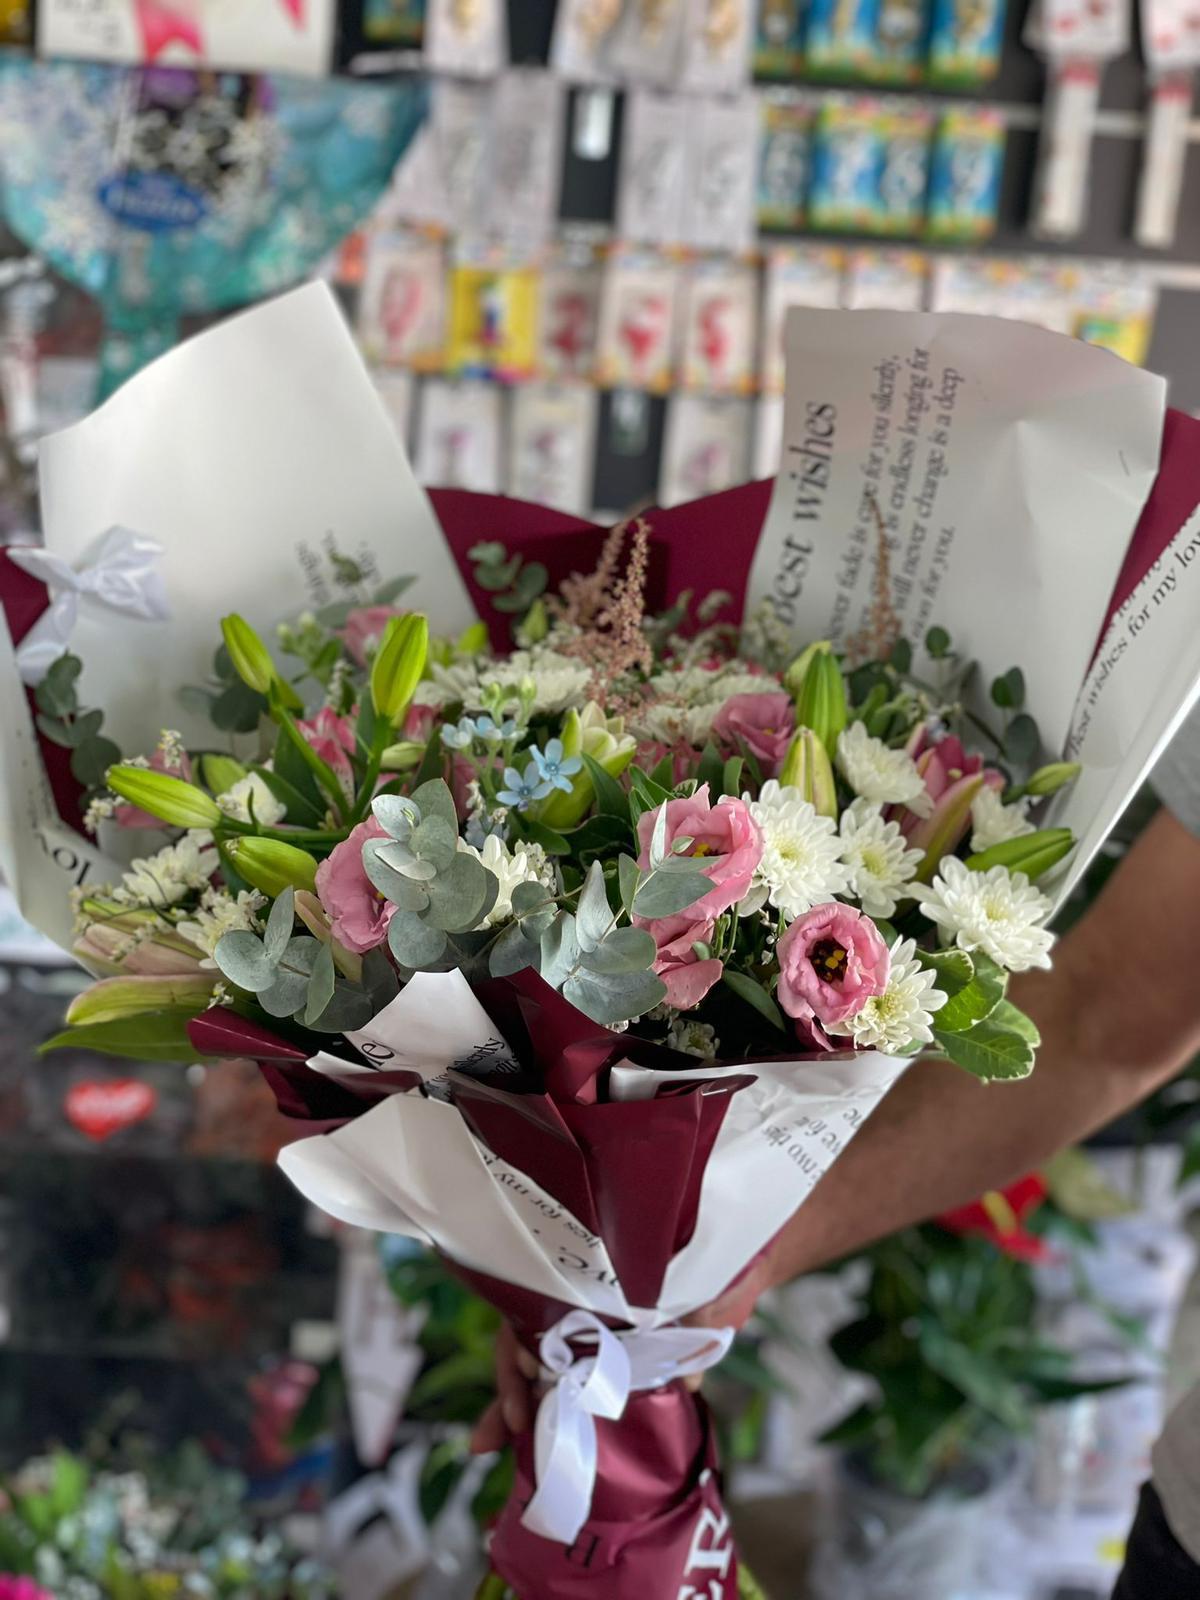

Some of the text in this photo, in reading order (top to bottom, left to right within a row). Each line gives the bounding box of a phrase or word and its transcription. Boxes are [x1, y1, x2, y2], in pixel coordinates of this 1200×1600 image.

[906, 346, 930, 372] for
[897, 374, 932, 436] longing
[932, 367, 966, 410] deep
[871, 415, 891, 454] you
[927, 428, 948, 447] is
[936, 413, 953, 427] a
[860, 449, 883, 480] for
[911, 449, 949, 519] change
[775, 400, 838, 627] Best wishes
[848, 526, 867, 544] is
[902, 520, 927, 575] never
[920, 567, 942, 599] for
[1088, 637, 1128, 706] wishes
[1127, 605, 1151, 637] for
[1152, 565, 1177, 606] my
[530, 1198, 562, 1220] for
